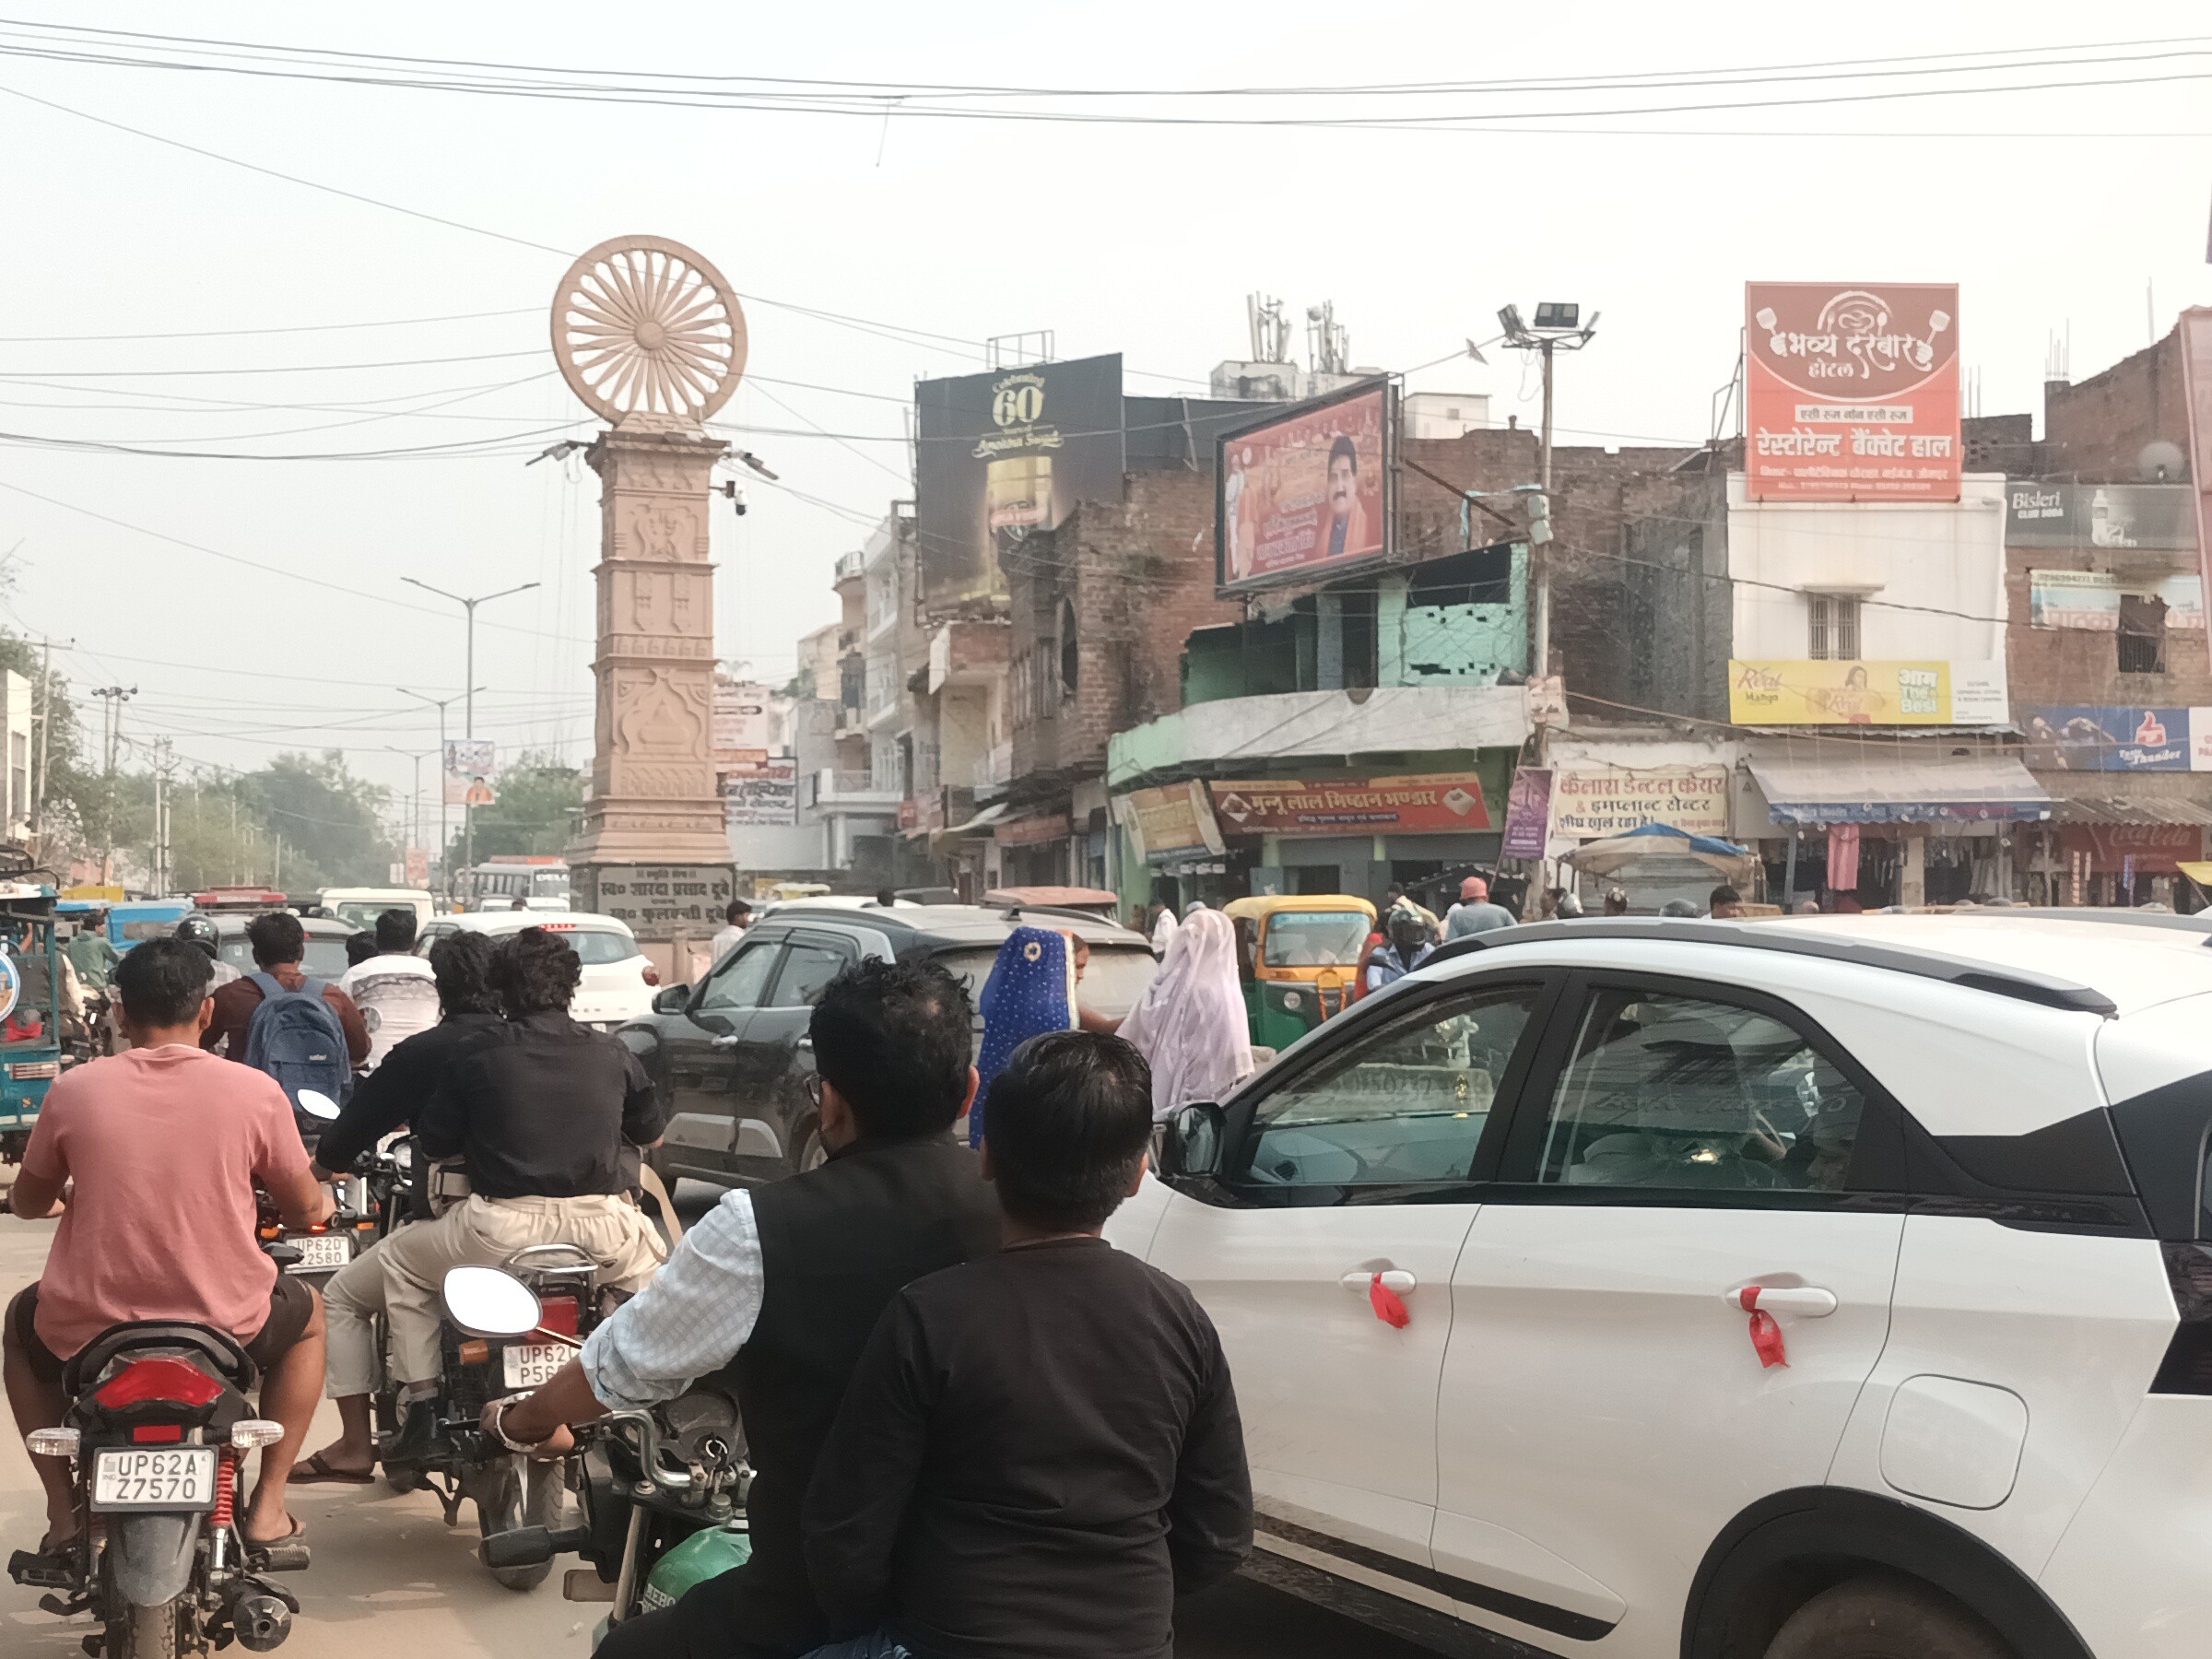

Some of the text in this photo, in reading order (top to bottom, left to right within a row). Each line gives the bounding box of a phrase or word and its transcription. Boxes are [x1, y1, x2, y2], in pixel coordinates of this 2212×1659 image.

[1789, 333, 1932, 379] भव्य दरबार
[1808, 358, 1854, 378] होटल
[993, 386, 1043, 426] 60
[1910, 435, 1952, 457] हाल
[2013, 489, 2061, 509] Bisleri
[1288, 794, 1323, 810] लाल
[300, 1252, 342, 1265] 2580
[119, 1454, 196, 1476] UP62A
[116, 1477, 196, 1500] Z7570
